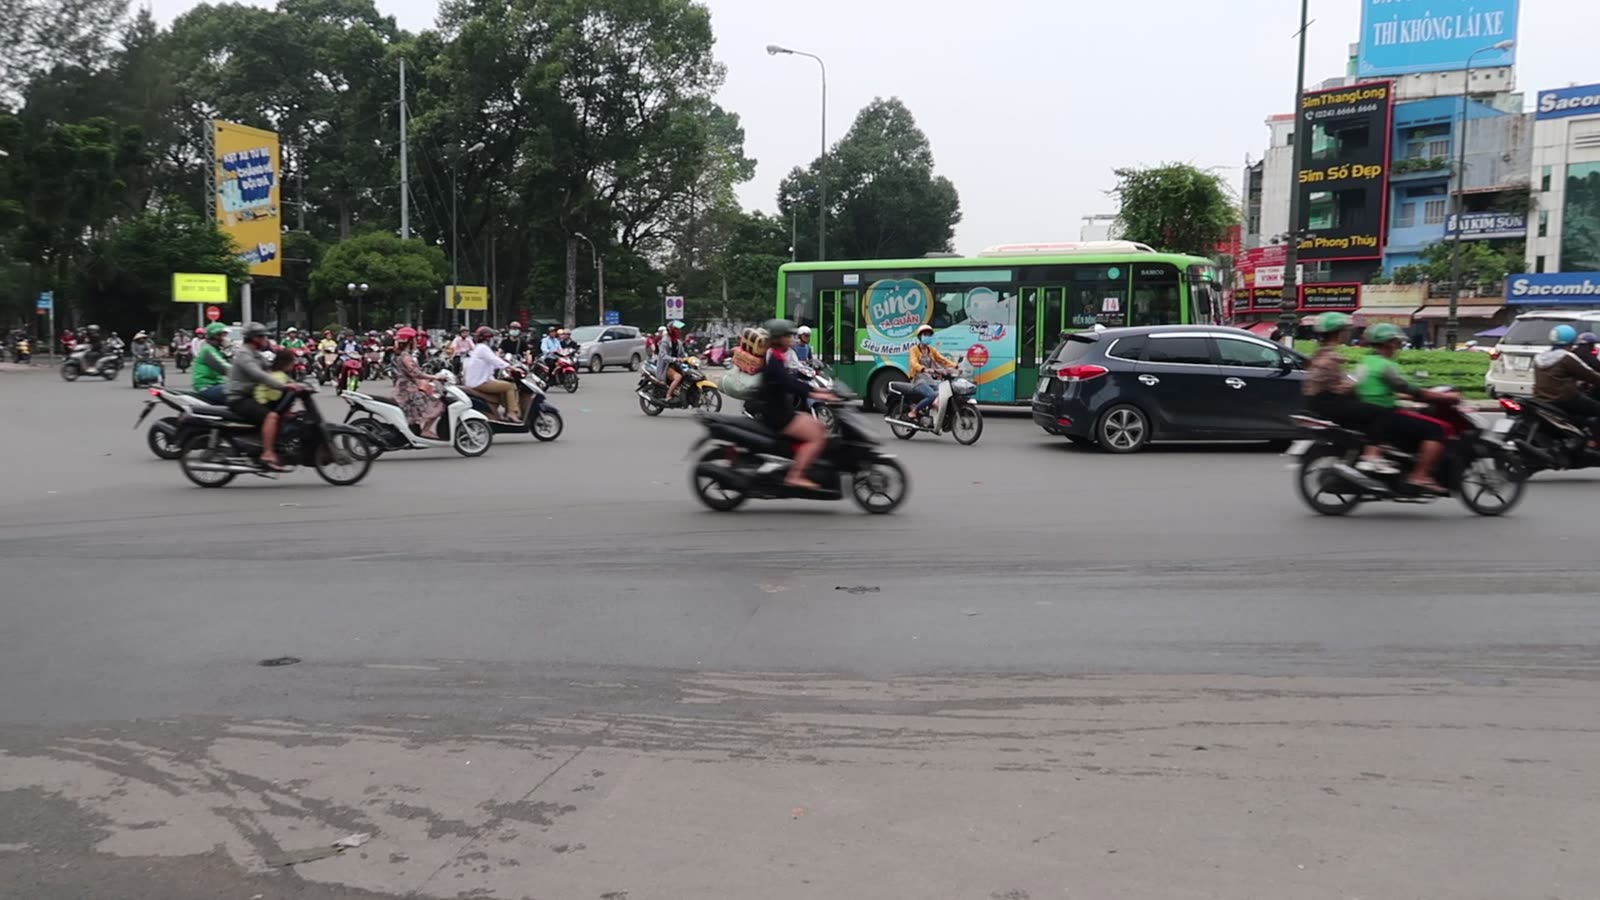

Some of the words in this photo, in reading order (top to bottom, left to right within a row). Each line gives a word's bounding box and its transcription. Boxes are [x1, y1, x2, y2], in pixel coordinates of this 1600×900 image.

[1400, 10, 1452, 44] KHÔNG
[1455, 7, 1480, 38] LÁI
[1483, 11, 1505, 35] XE
[1298, 169, 1324, 183] Sim
[1327, 164, 1348, 180] Số
[1352, 164, 1381, 180] Đẹp
[1315, 237, 1349, 248] Phong
[1105, 299, 1117, 310] 14
